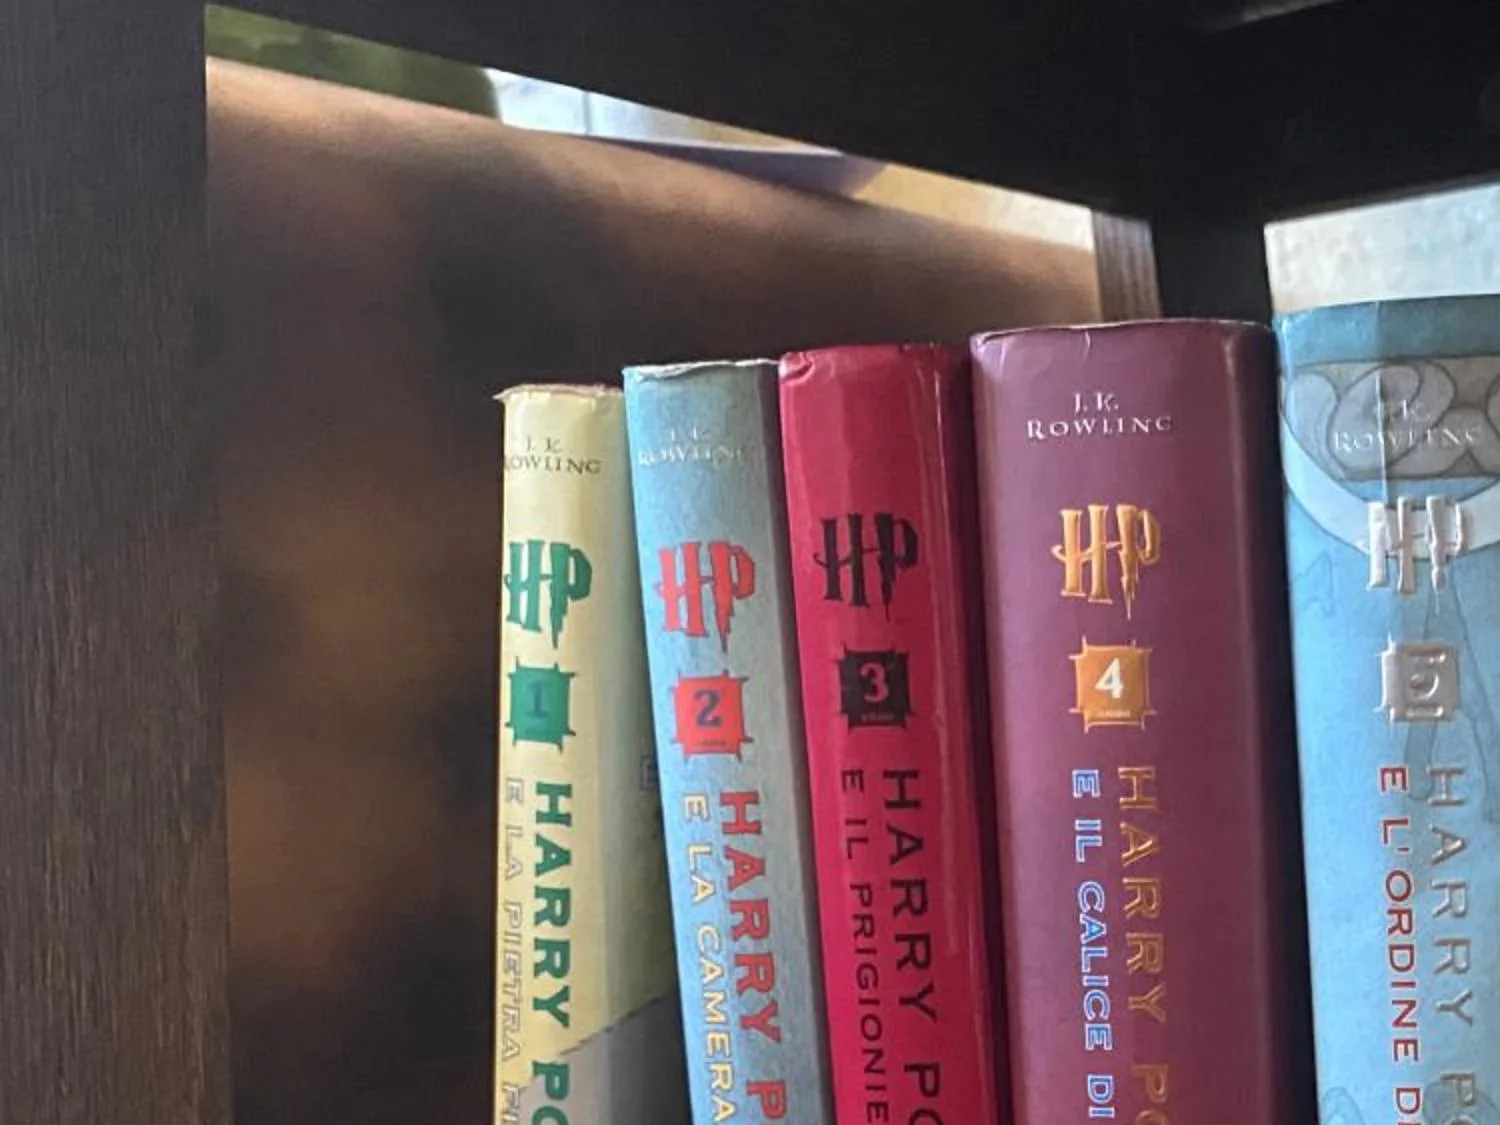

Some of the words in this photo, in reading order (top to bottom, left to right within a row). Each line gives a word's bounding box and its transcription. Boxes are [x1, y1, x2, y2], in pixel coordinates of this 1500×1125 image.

[1026, 415, 1173, 441] ROWLING
[504, 540, 593, 649] HP
[653, 539, 756, 653] HP
[813, 512, 919, 622] HP
[1051, 503, 1162, 621] HP
[1355, 495, 1470, 614] HP
[860, 661, 889, 703] 3
[1095, 657, 1124, 699] 4
[506, 777, 525, 805] E
[683, 793, 710, 822] E
[840, 768, 866, 793] E
[1071, 767, 1100, 799] E
[1379, 765, 1408, 793] E
[504, 825, 523, 881] LA
[687, 843, 717, 904] LA
[844, 817, 870, 860] IL
[1074, 818, 1103, 862] IL
[532, 781, 574, 1029] HARRY
[718, 790, 781, 1044] HARRY
[882, 768, 937, 1024] HARRY
[1117, 764, 1167, 1023] HARRY
[1380, 818, 1420, 1063] L'ORDINE
[1427, 765, 1474, 1027] HARRY
[500, 900, 523, 1061] PIETRA
[1076, 879, 1113, 1052] CALICE
[697, 924, 738, 1124] CAMERA
[1087, 1073, 1116, 1119] DI
